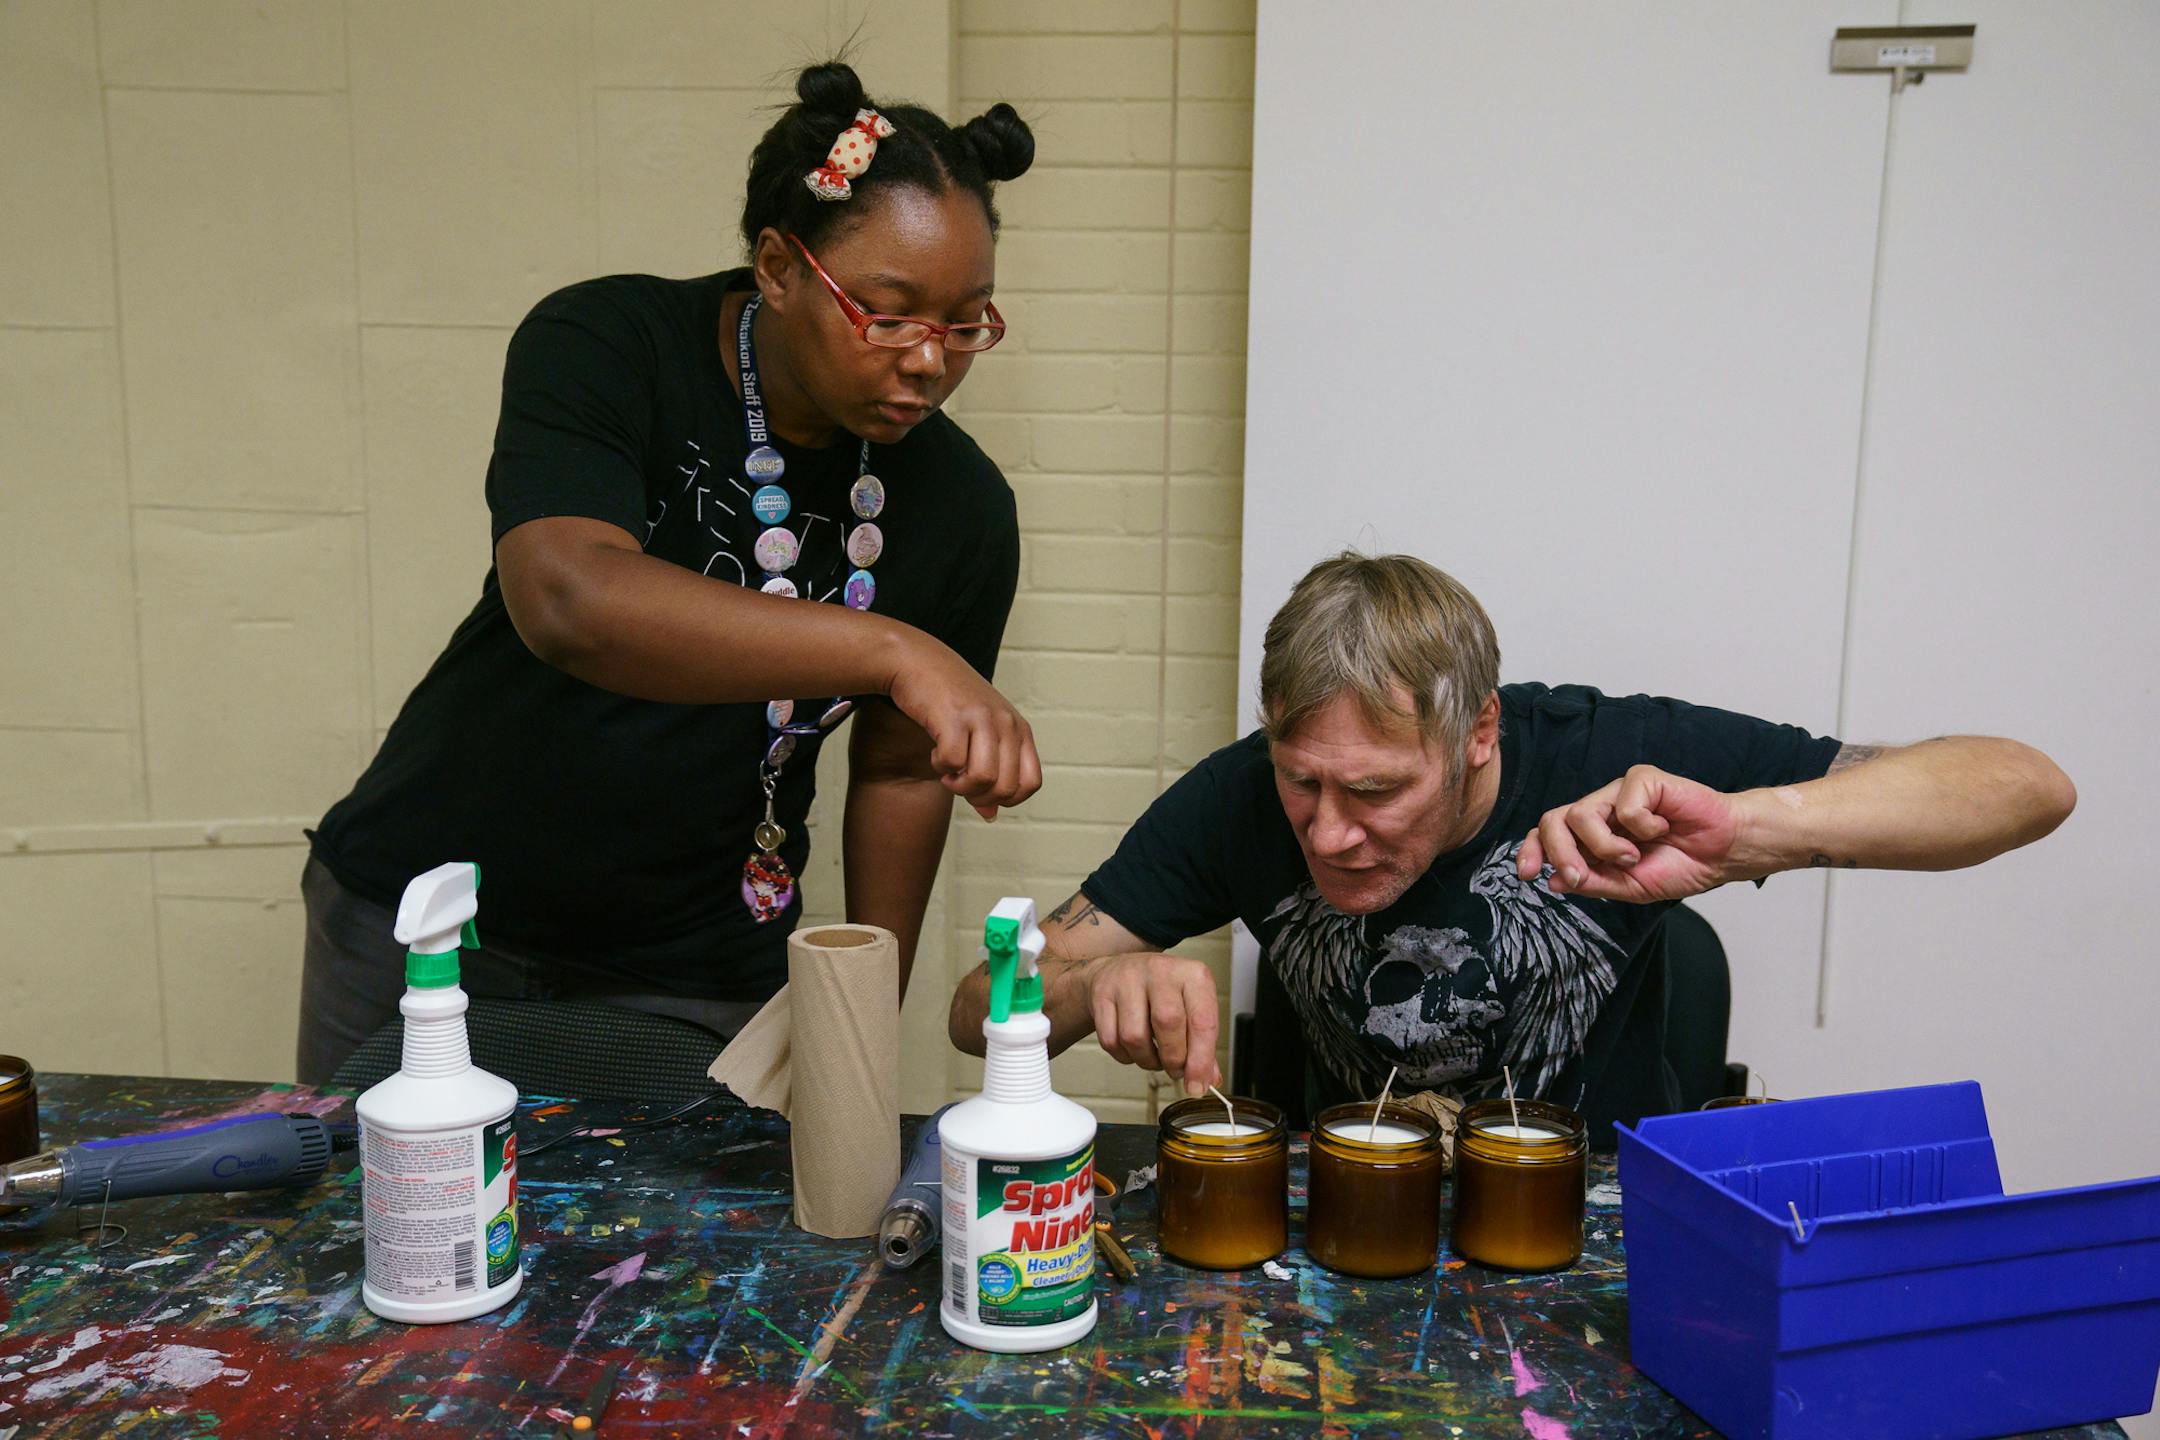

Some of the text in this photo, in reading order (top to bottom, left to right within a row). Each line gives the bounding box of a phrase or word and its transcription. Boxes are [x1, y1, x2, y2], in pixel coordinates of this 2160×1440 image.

[740, 302, 759, 369] Zenkaikon
[743, 372, 761, 406] Staff
[747, 409, 767, 442] 2019
[757, 502, 787, 510] KINDNESS
[1003, 1157, 1094, 1216] Spra
[1009, 1201, 1093, 1253] Nine
[1027, 1235, 1094, 1273] Heavy-Du
